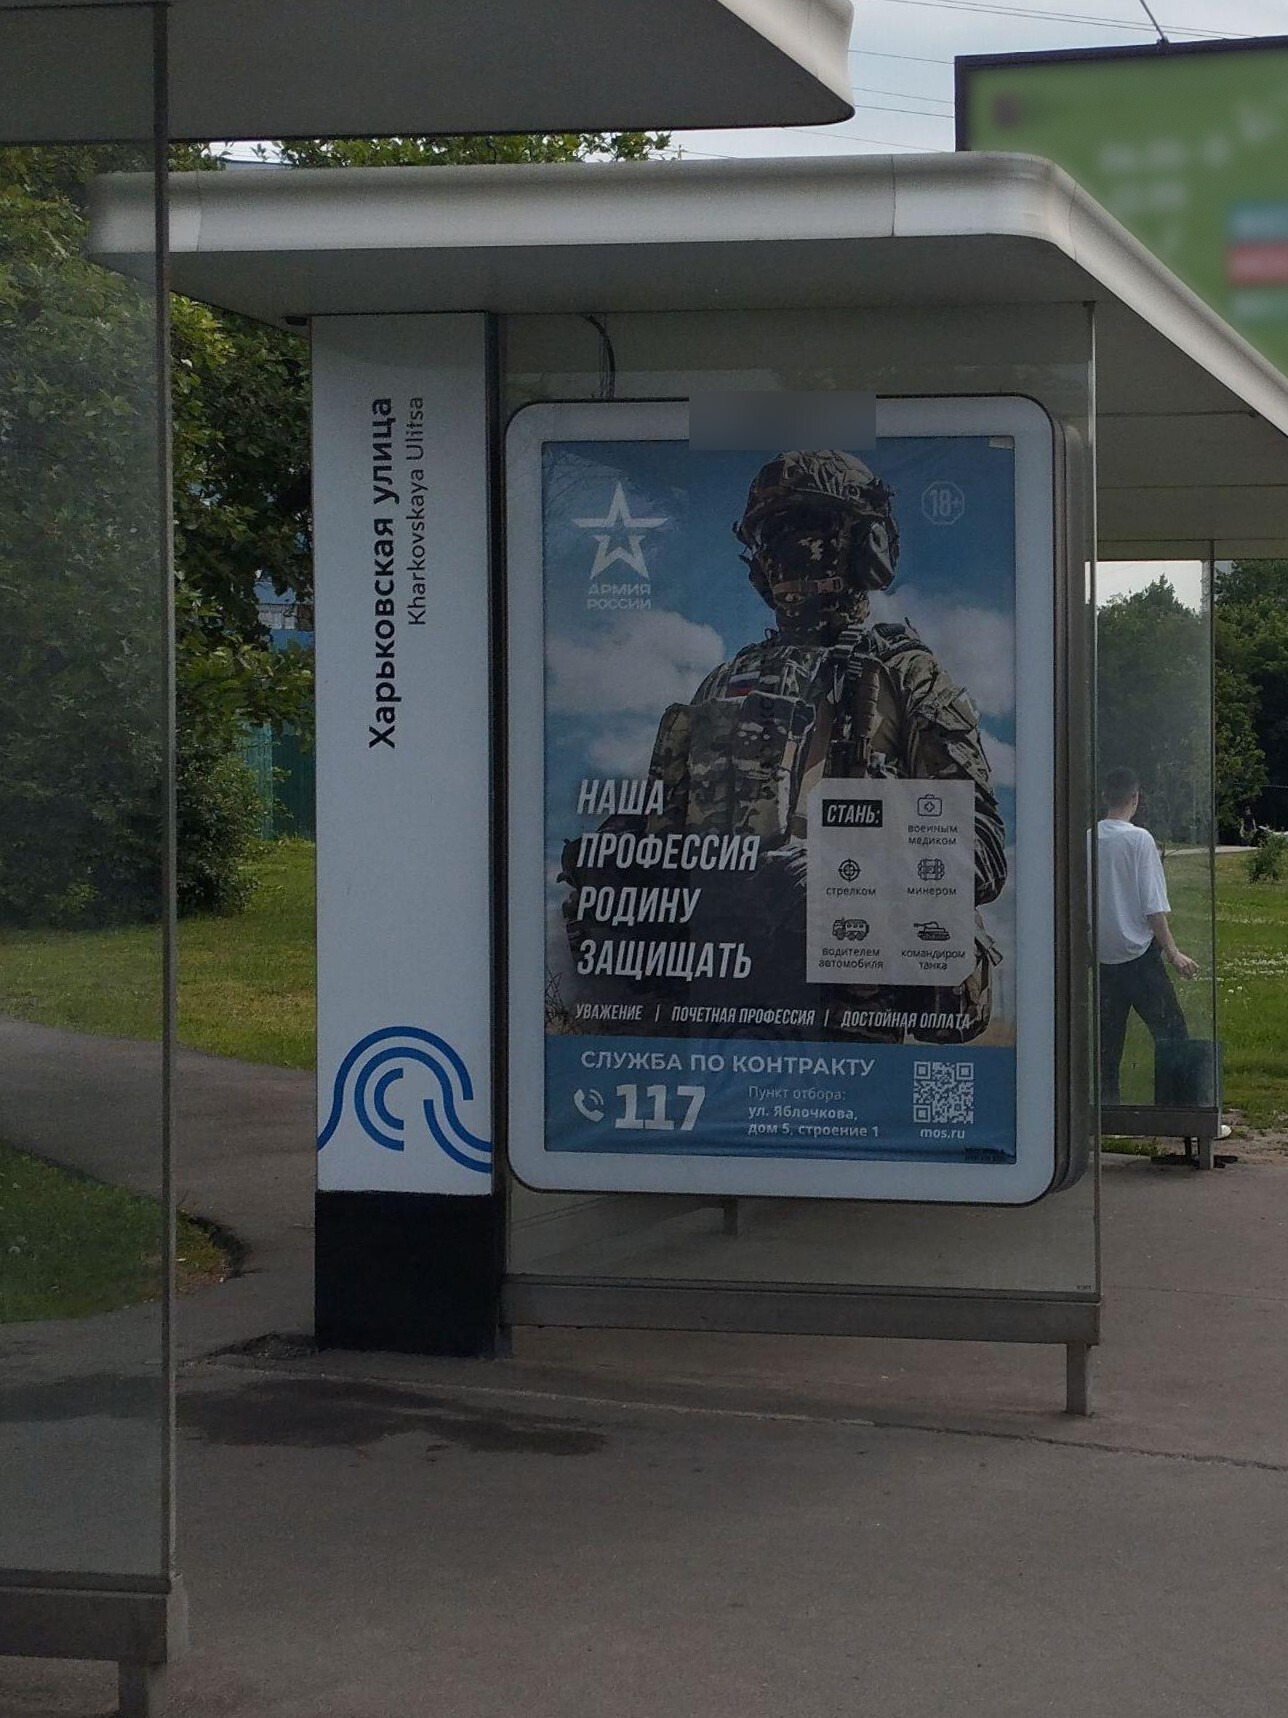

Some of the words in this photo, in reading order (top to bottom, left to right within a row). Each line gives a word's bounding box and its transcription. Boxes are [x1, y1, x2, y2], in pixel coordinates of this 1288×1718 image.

[405, 397, 425, 460] Ulitsa
[372, 398, 400, 505] улица
[929, 489, 962, 517] 18+
[405, 469, 429, 625] Kharkovskaya
[588, 583, 651, 595] АРМИЯ
[587, 598, 651, 610] РОССИИ
[369, 518, 402, 749] Харьковская
[577, 779, 664, 815] НАША
[826, 804, 881, 825] СТАНЬ:
[907, 824, 958, 834] военным
[908, 836, 957, 846] медиком
[577, 832, 761, 871] ПРОФЕССИЯ
[826, 887, 876, 898] стрелком
[907, 887, 957, 897] минером
[577, 886, 701, 927] РОДИНУ
[577, 939, 752, 982] ЗАЩИЩАТЬ
[822, 948, 880, 958] водителем
[901, 949, 966, 960] командиром
[819, 958, 884, 969] автомобиля
[919, 961, 948, 971] танка
[575, 1003, 644, 1021] УВАЖЕНИЕ
[671, 1005, 737, 1023] ПОЧЕТНАЯ
[738, 1007, 816, 1025] ПРОФЕССИЯ
[841, 1009, 917, 1029] ДОСТОЙНАЯ
[919, 1012, 971, 1030] ОПЛАТА
[581, 1050, 683, 1071] СЛУЖБА
[690, 1054, 725, 1072] ПО
[733, 1056, 876, 1077] КОНТРАКТУ
[749, 1086, 791, 1100] Пункт
[793, 1086, 846, 1102] отбора:
[614, 1083, 707, 1131] 117
[748, 1107, 769, 1120] ул.
[774, 1106, 858, 1121] Яблочкова,
[748, 1125, 778, 1136] дом
[782, 1122, 793, 1136] 5,
[799, 1125, 868, 1138] строение
[872, 1126, 880, 1137] 1
[920, 1126, 965, 1139] mos.ru
